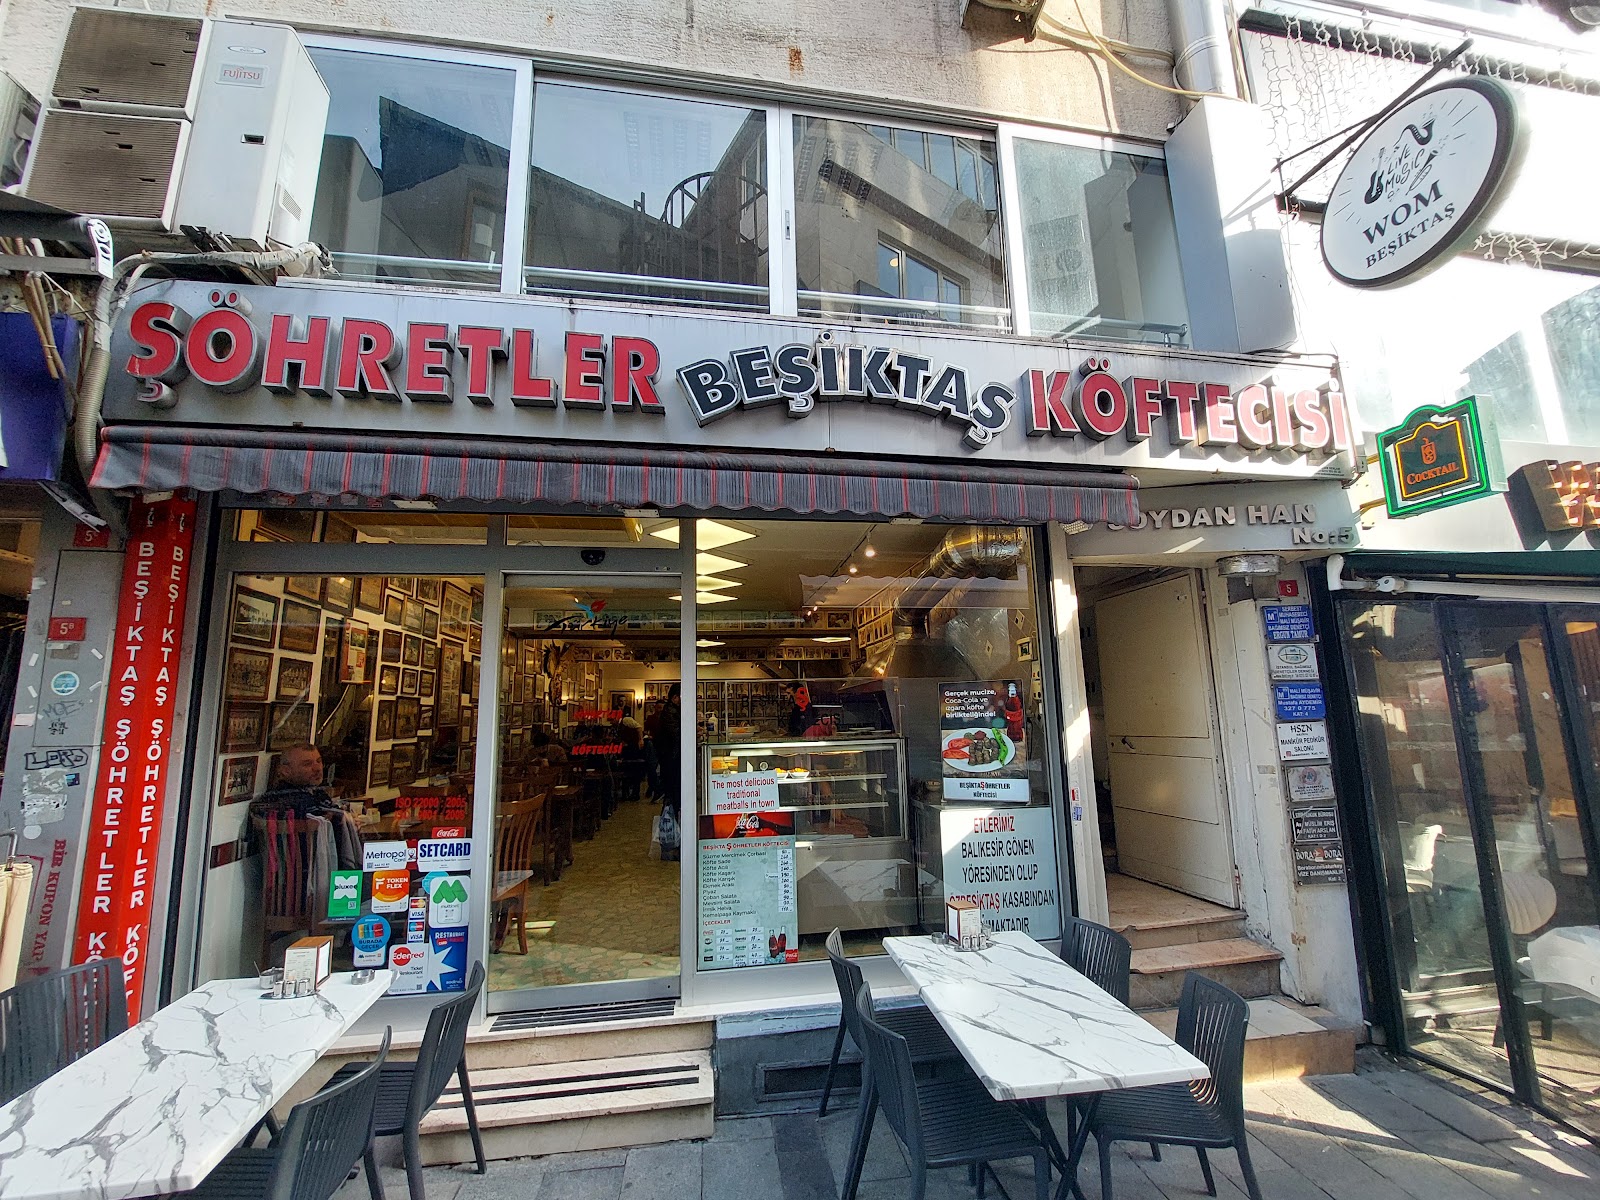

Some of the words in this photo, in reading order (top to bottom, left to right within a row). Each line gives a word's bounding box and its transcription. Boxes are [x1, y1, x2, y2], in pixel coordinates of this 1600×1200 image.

[223, 67, 260, 80] FUJITSU
[1362, 179, 1443, 245] WOM
[1365, 202, 1456, 269] BEŞİKTAŞ
[126, 290, 666, 415] ŞÖHRETLER
[676, 330, 1018, 450] BEŞİKTAŞ
[1026, 356, 1349, 452] KÖFTECİSİ
[1246, 503, 1316, 525] HAN
[1286, 584, 1292, 594] 5
[119, 541, 155, 707] BEŞİKTAŞ
[154, 545, 185, 707] BEŞİKTAŞ
[944, 689, 969, 697] Gerçek
[969, 688, 997, 696] mucize,
[711, 780, 725, 790] The
[726, 779, 744, 789] most
[744, 776, 775, 787] delicious
[726, 788, 761, 800] traditional
[93, 718, 132, 914] ŞÖHRETLER
[130, 718, 164, 909] ŞÖHRETLER
[716, 800, 749, 812] meatballs
[758, 799, 775, 808] town
[973, 812, 1016, 834] ETLERİMİZ
[365, 849, 407, 860] Metropol
[419, 842, 471, 858] SETCARD
[961, 837, 1005, 859] BALIKESİR
[1005, 836, 1035, 857] GÖNEN
[962, 863, 1015, 884] YÖRESİNDEN
[1016, 863, 1038, 881] OLUP
[38, 871, 61, 927] KUPON
[1002, 889, 1055, 909] KASABINDAN
[434, 931, 465, 939] RESTAURANT
[392, 951, 425, 960] Edenred
